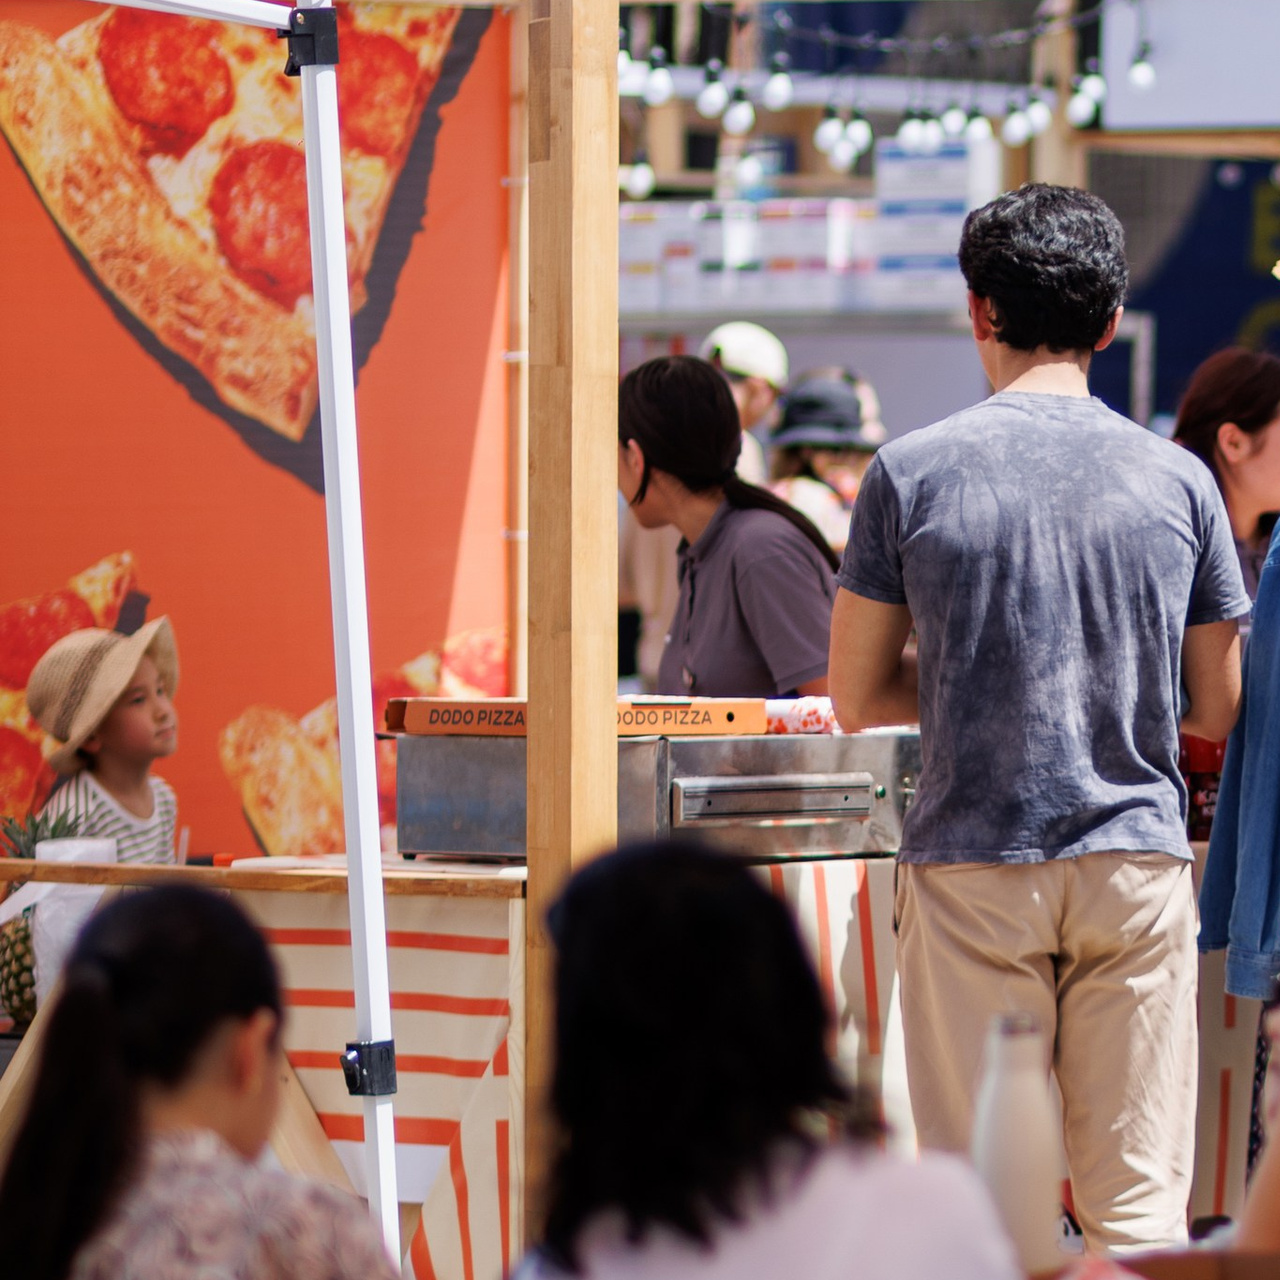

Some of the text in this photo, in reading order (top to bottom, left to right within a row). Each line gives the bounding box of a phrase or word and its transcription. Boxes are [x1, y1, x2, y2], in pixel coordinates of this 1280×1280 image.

[428, 708, 526, 728] DODO PIZZA
[662, 710, 713, 726] PIZZA
